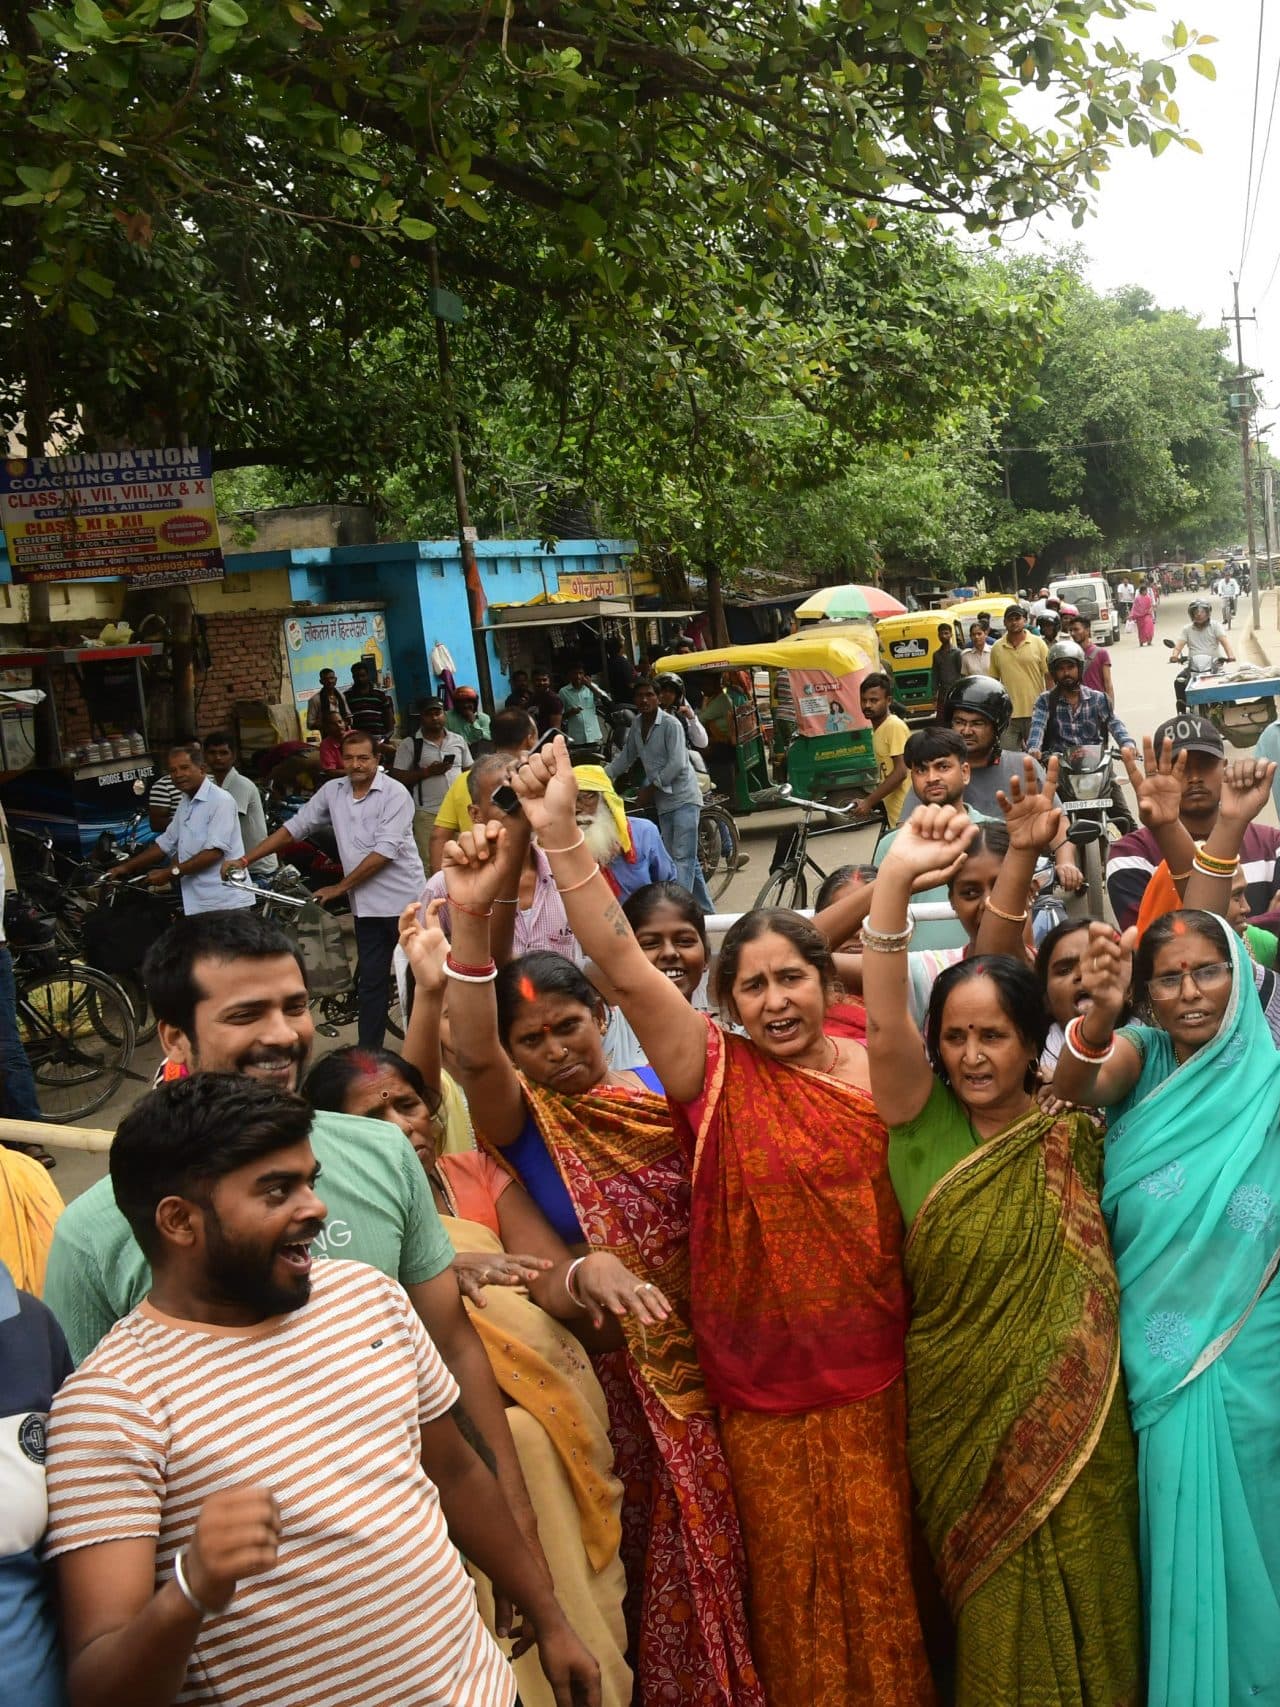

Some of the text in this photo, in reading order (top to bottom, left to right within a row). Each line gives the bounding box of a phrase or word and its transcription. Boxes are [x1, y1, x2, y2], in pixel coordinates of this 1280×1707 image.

[9, 466, 203, 490] COACHING CENTRE
[157, 483, 174, 497] IX
[180, 482, 190, 495] &
[194, 481, 206, 494] X
[120, 502, 136, 511] All
[138, 500, 177, 510] Boards
[86, 517, 102, 530] XI
[121, 515, 143, 528] XII
[15, 545, 48, 555] ARTS
[571, 576, 615, 598] शौचालय
[303, 620, 329, 642] लोकतंत्र
[1164, 719, 1202, 743] BOY
